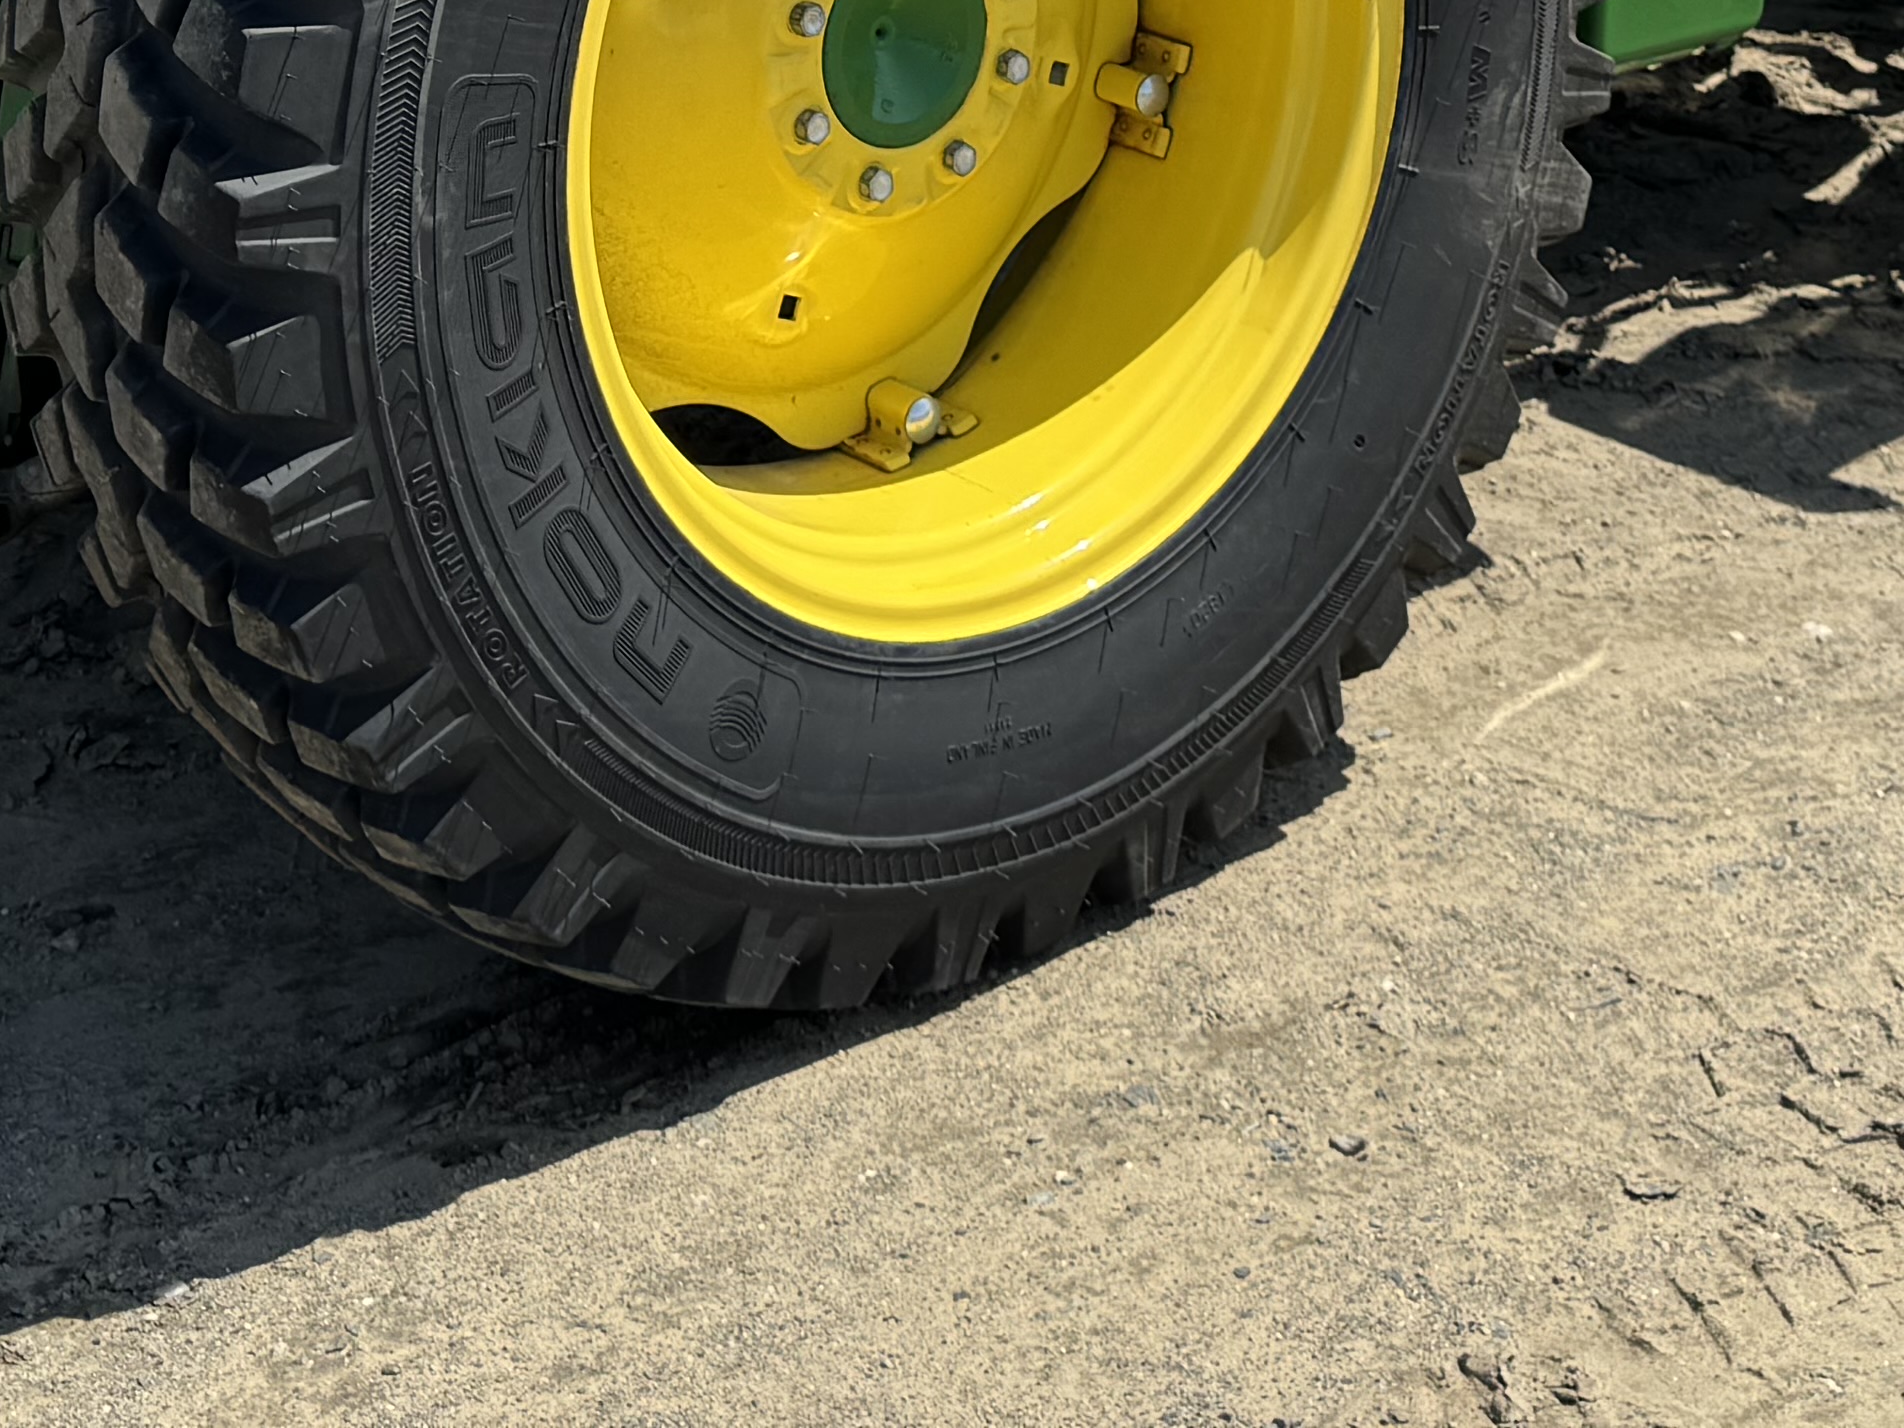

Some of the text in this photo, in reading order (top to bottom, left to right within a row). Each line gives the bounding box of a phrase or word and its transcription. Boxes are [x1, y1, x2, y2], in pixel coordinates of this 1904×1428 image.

[1458, 44, 1491, 168] M+S
[463, 111, 695, 706] NOKIAN
[1413, 258, 1510, 477] ROTATION
[408, 460, 529, 694] ROTATION
